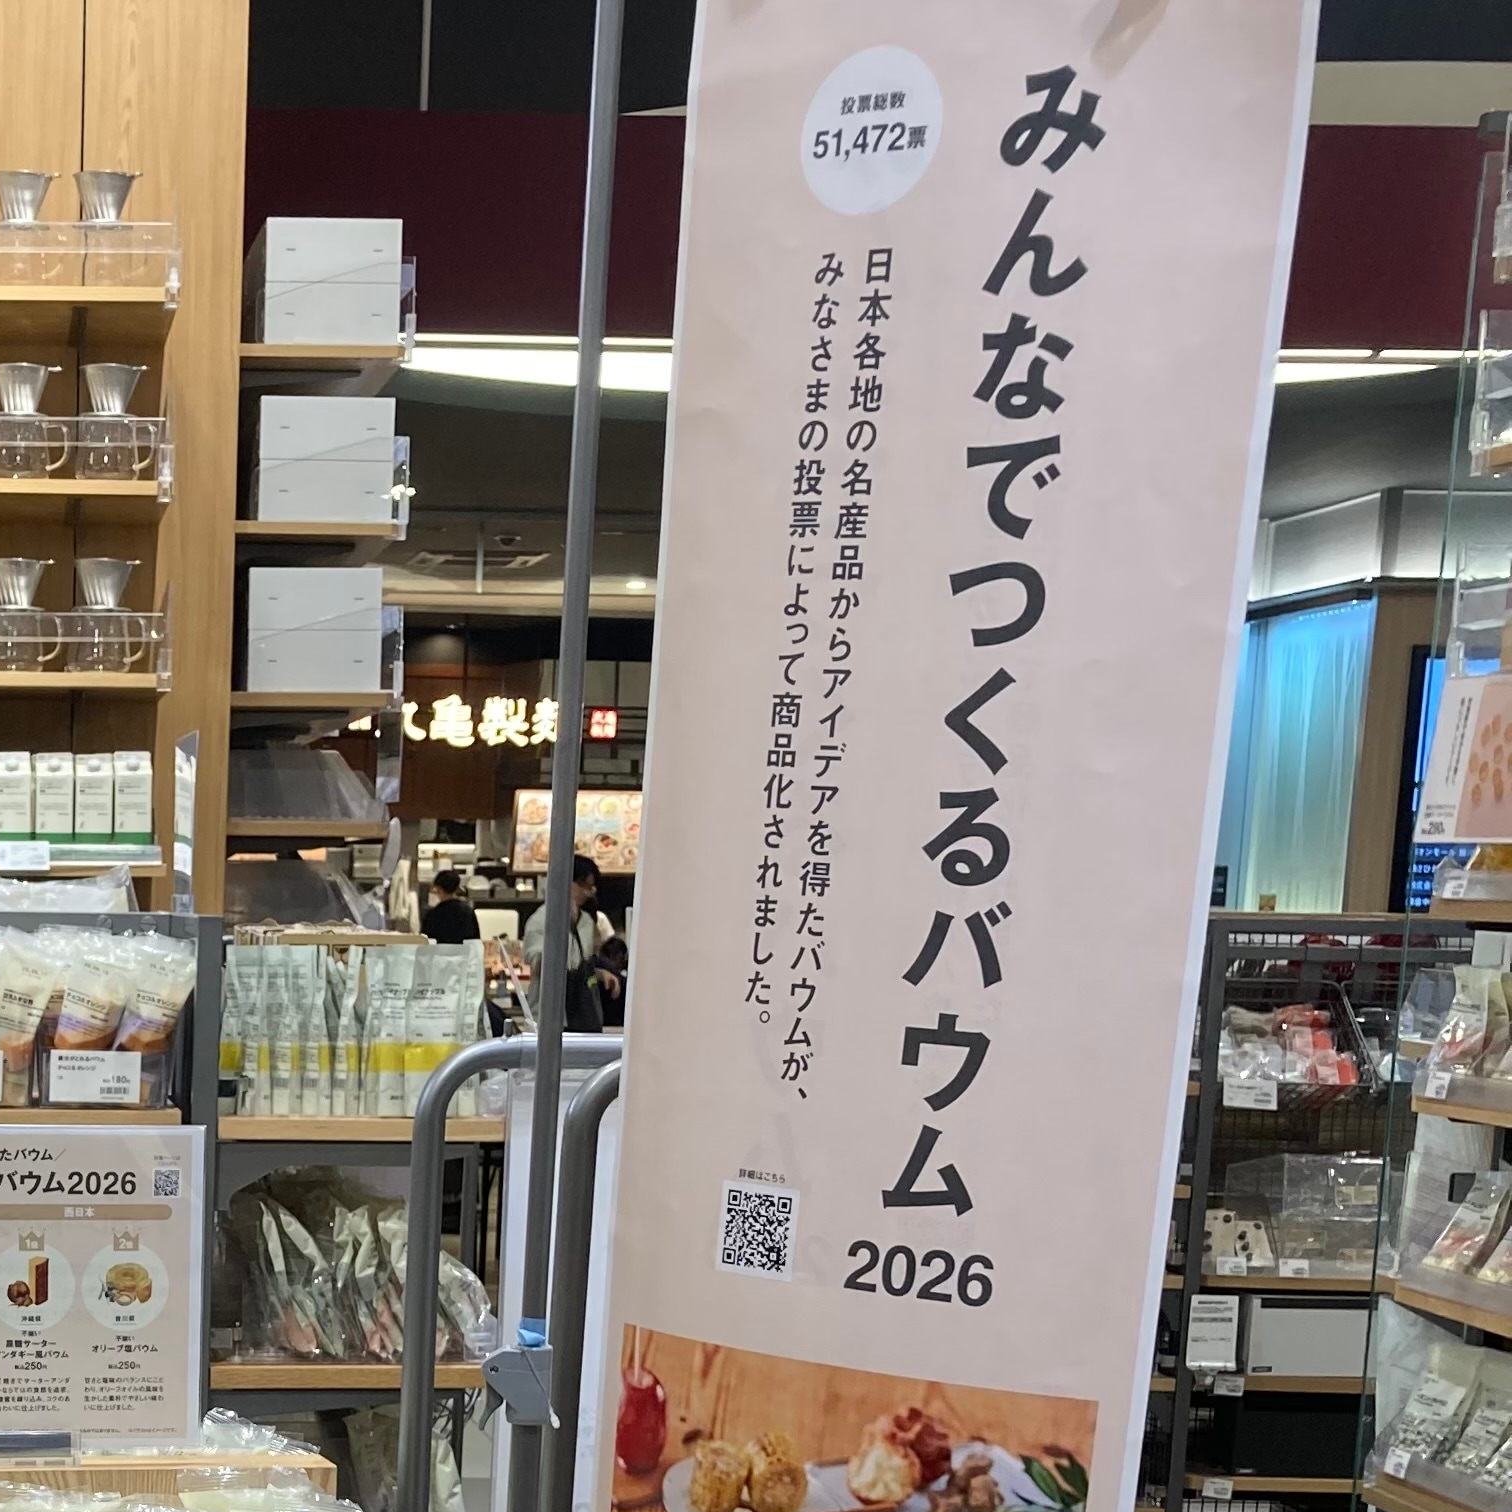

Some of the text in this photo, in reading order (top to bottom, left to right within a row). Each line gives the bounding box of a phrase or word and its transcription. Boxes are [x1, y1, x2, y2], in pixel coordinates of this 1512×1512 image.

[841, 90, 906, 115] 投票総数
[812, 122, 928, 161] 51,472票
[744, 252, 844, 1025] みなさまの投票によって商品化されました。
[881, 65, 1107, 1217] みんなでつくるバウム
[780, 248, 893, 1099] 日本各地の名産品からアイデアを得たバウムが、
[738, 1168, 786, 1184] 詳細はこちら
[843, 1240, 995, 1306] 2026
[5, 1339, 57, 1348] 黒糖サーター
[91, 1344, 159, 1353] オリーブ塩バウム
